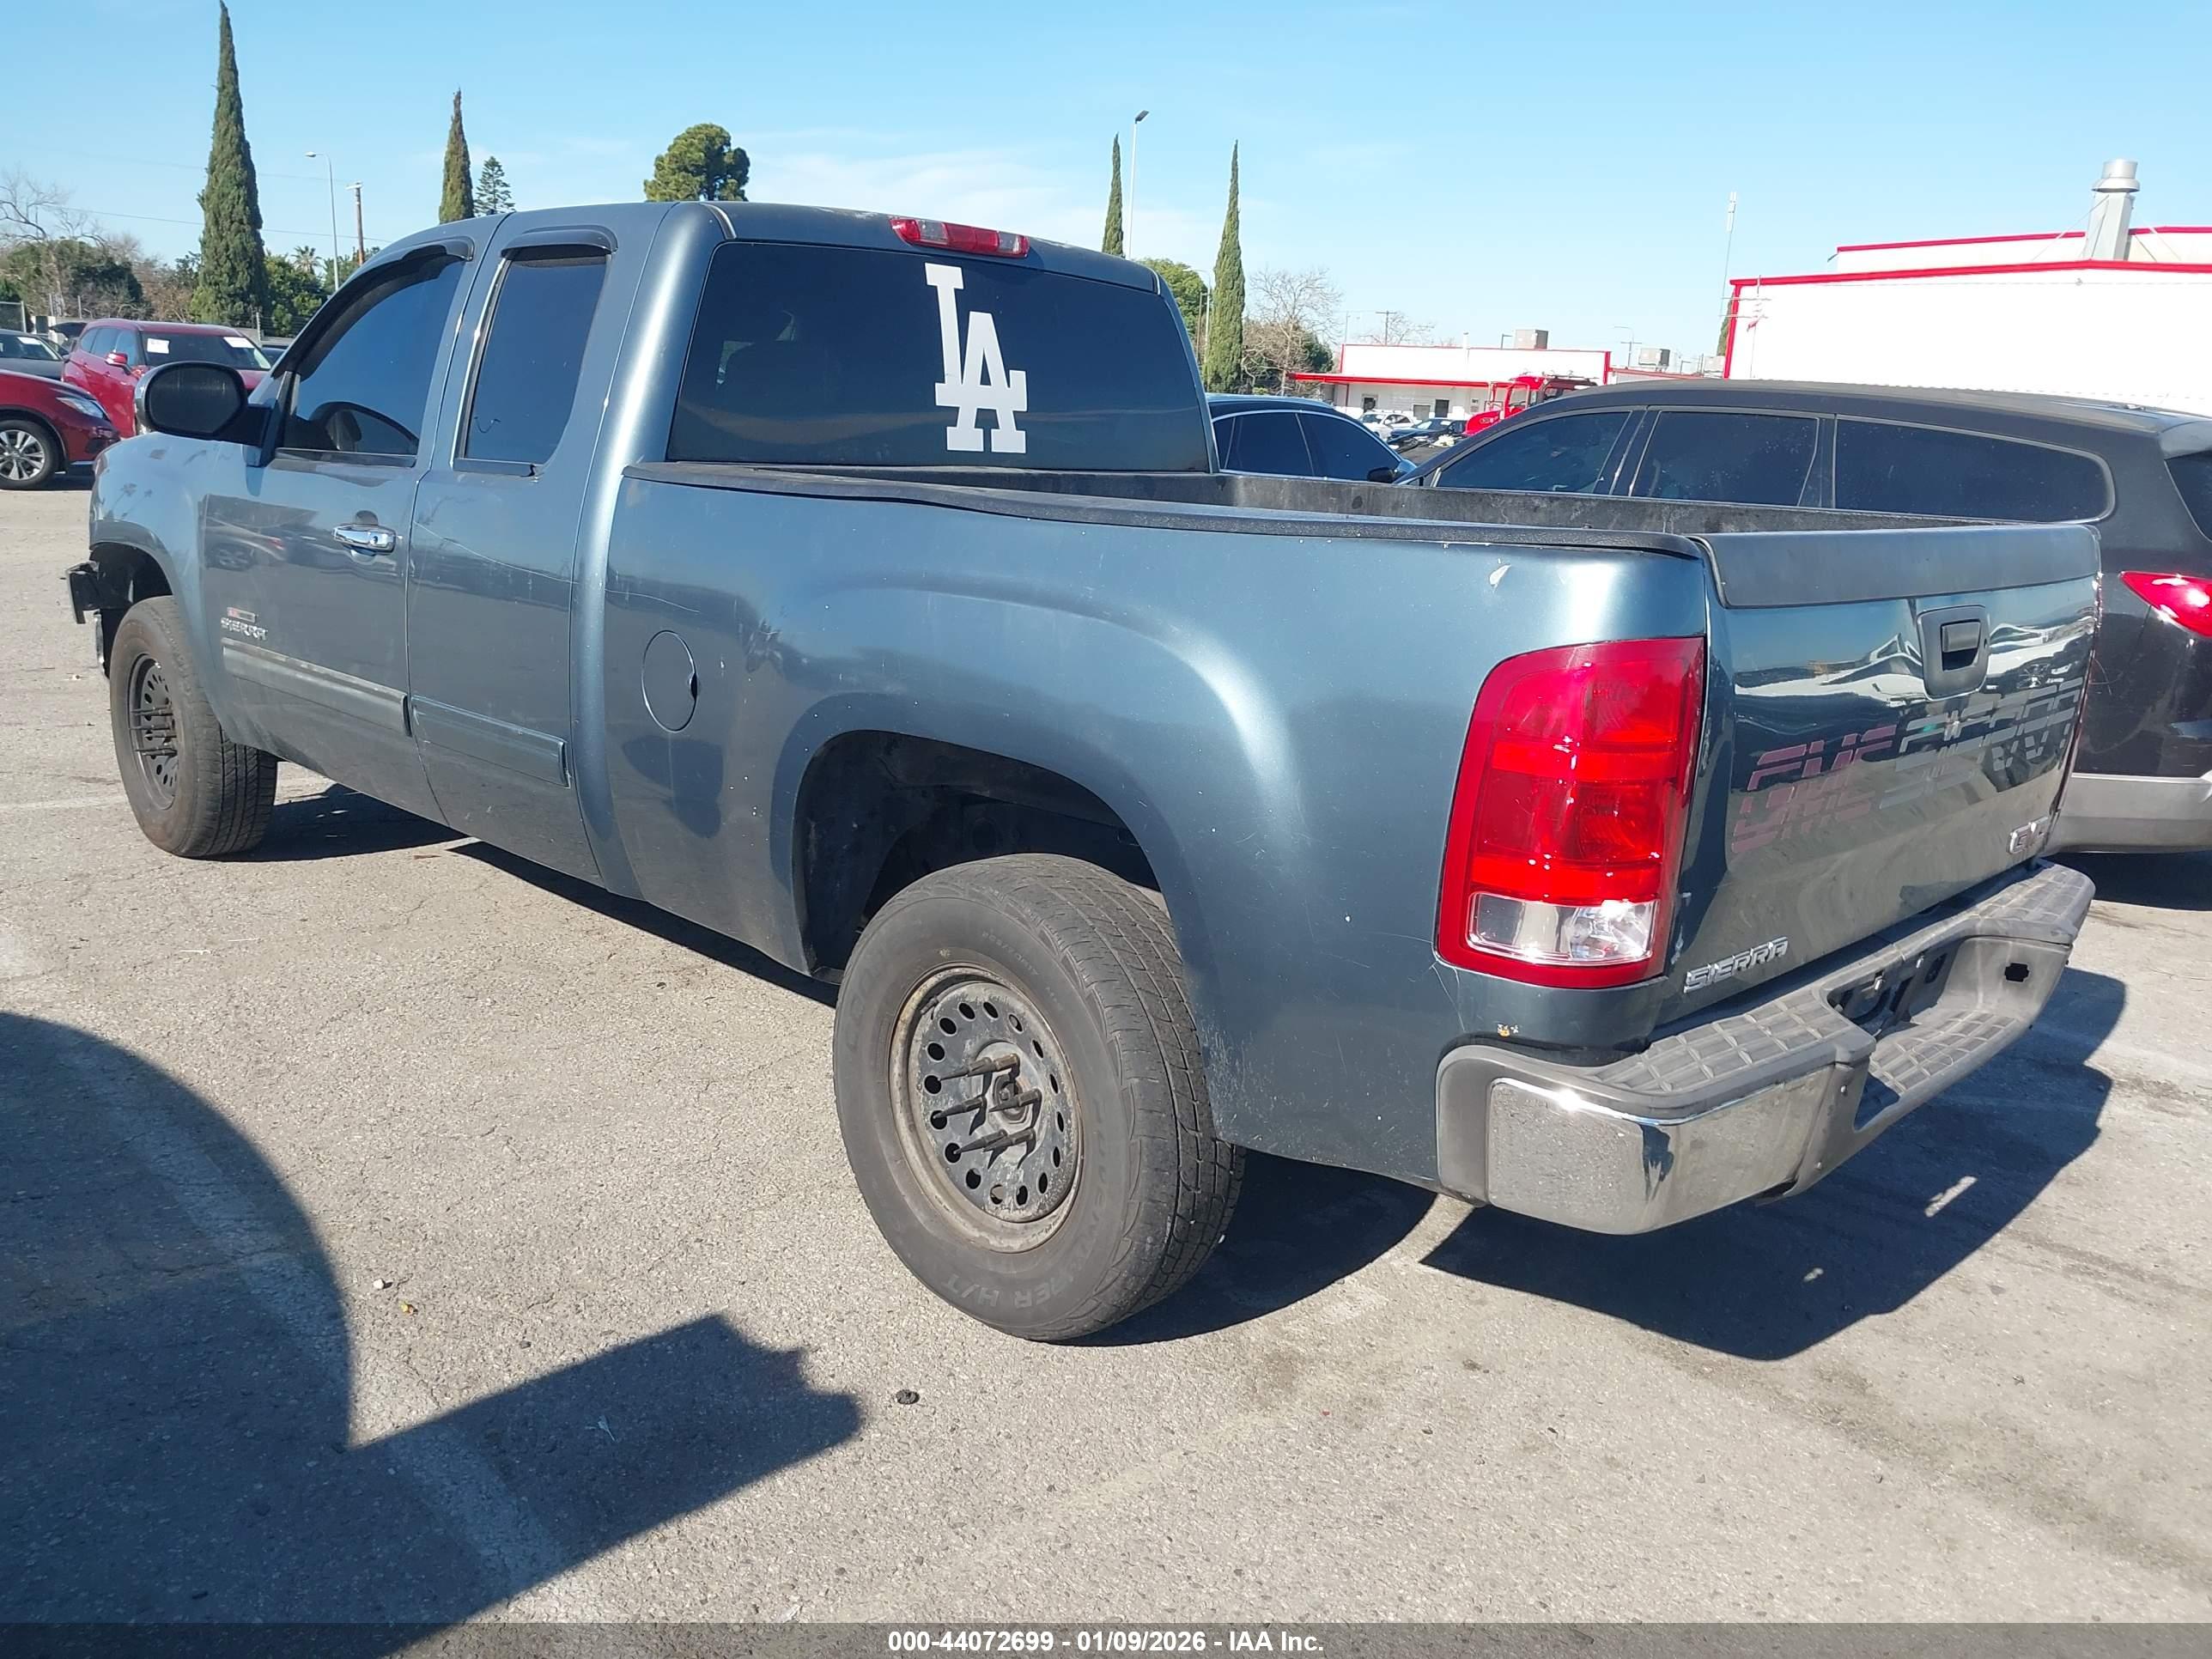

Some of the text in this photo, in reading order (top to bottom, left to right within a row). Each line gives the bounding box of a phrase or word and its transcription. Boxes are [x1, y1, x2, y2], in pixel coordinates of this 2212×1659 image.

[925, 262, 1028, 453] LA
[1684, 936, 1789, 994] SIERRA
[942, 1274, 1000, 1308] H/T
